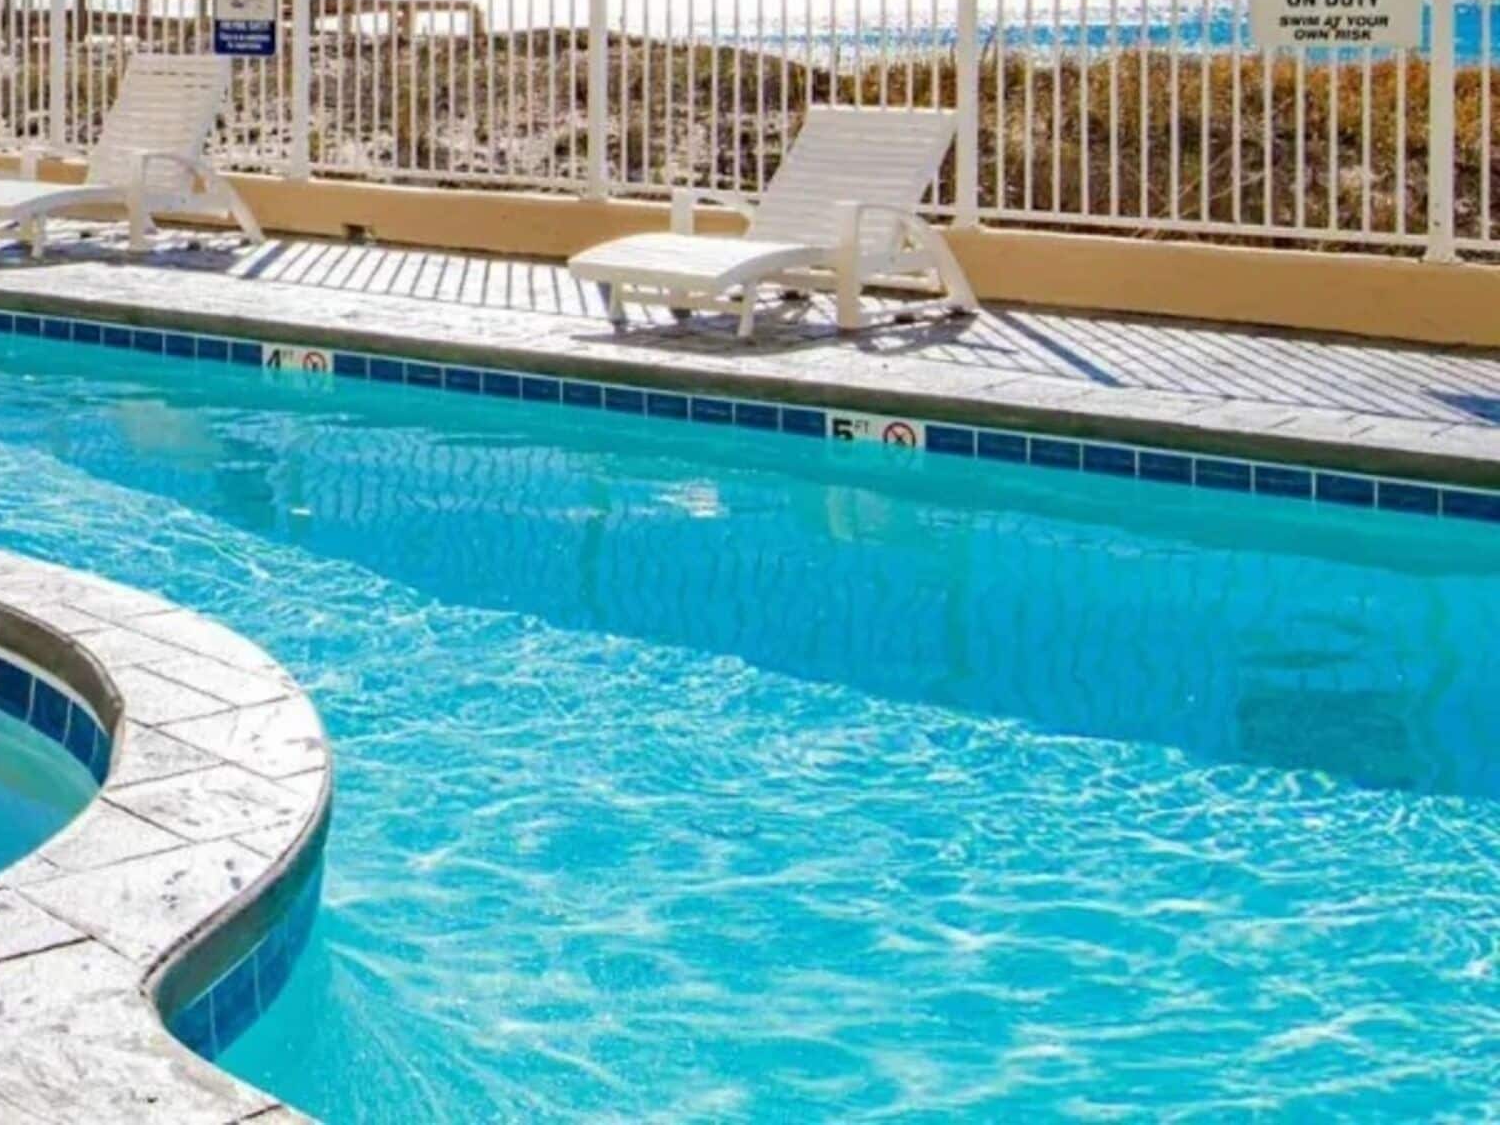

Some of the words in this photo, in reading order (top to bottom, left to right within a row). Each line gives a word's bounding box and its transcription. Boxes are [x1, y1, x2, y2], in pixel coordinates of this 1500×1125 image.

[1279, 16, 1320, 27] SWIM
[1324, 16, 1342, 27] AT
[1347, 16, 1389, 27] YOUR
[1294, 29, 1329, 40] OWN
[1334, 29, 1371, 40] RISK
[832, 418, 853, 442] 5
